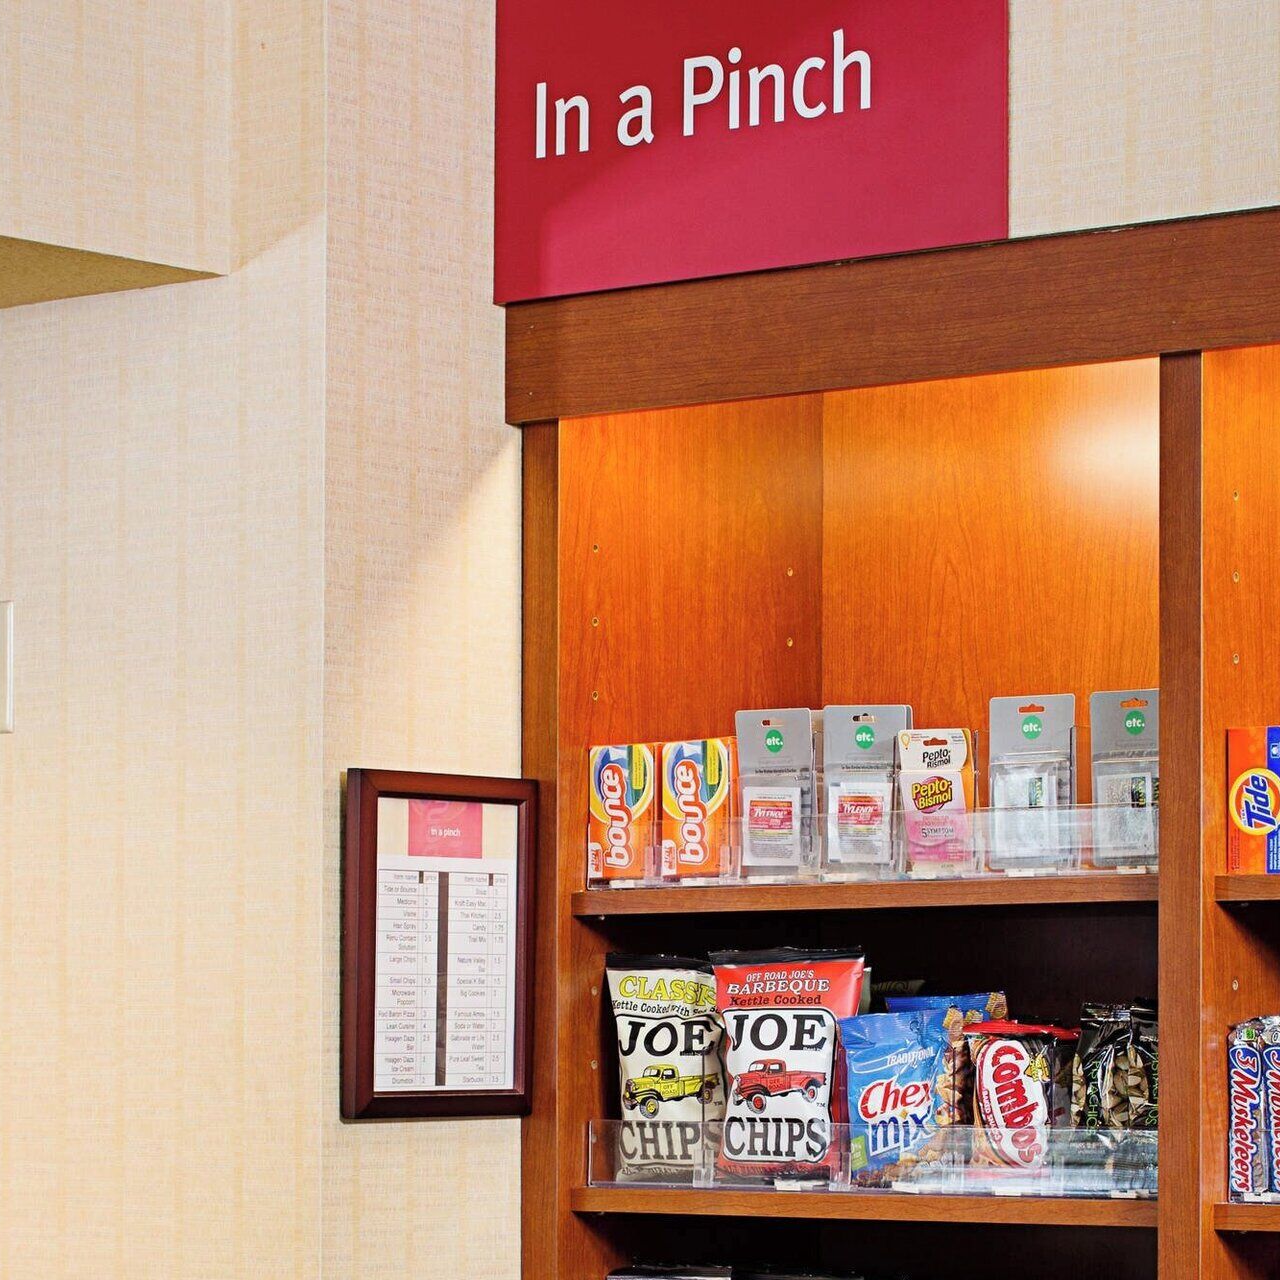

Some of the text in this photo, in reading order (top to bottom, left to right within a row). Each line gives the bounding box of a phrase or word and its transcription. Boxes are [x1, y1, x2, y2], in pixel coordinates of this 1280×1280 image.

[535, 28, 872, 159] In a Pinch
[856, 732, 875, 742] etc.
[1022, 723, 1042, 733] etc.
[1126, 718, 1145, 728] etc.
[765, 736, 784, 747] etc.
[922, 748, 951, 762] Pepto-
[911, 779, 953, 799] Pepto-
[917, 791, 953, 810] Bismol
[1242, 774, 1274, 829] Tide
[602, 764, 632, 868] bounce
[675, 760, 708, 866] bounce
[726, 979, 830, 995] BARBEQUE
[746, 970, 815, 983] OFF ROAD JOE'S
[729, 994, 822, 1007] Kettle Cooked
[619, 1020, 715, 1057] JOE
[730, 1014, 827, 1052] JOE
[859, 1082, 933, 1120] Chex
[991, 1044, 1043, 1165] Combos
[1230, 1050, 1262, 1193] 3 Musketeers
[724, 1116, 827, 1159] CHIPS
